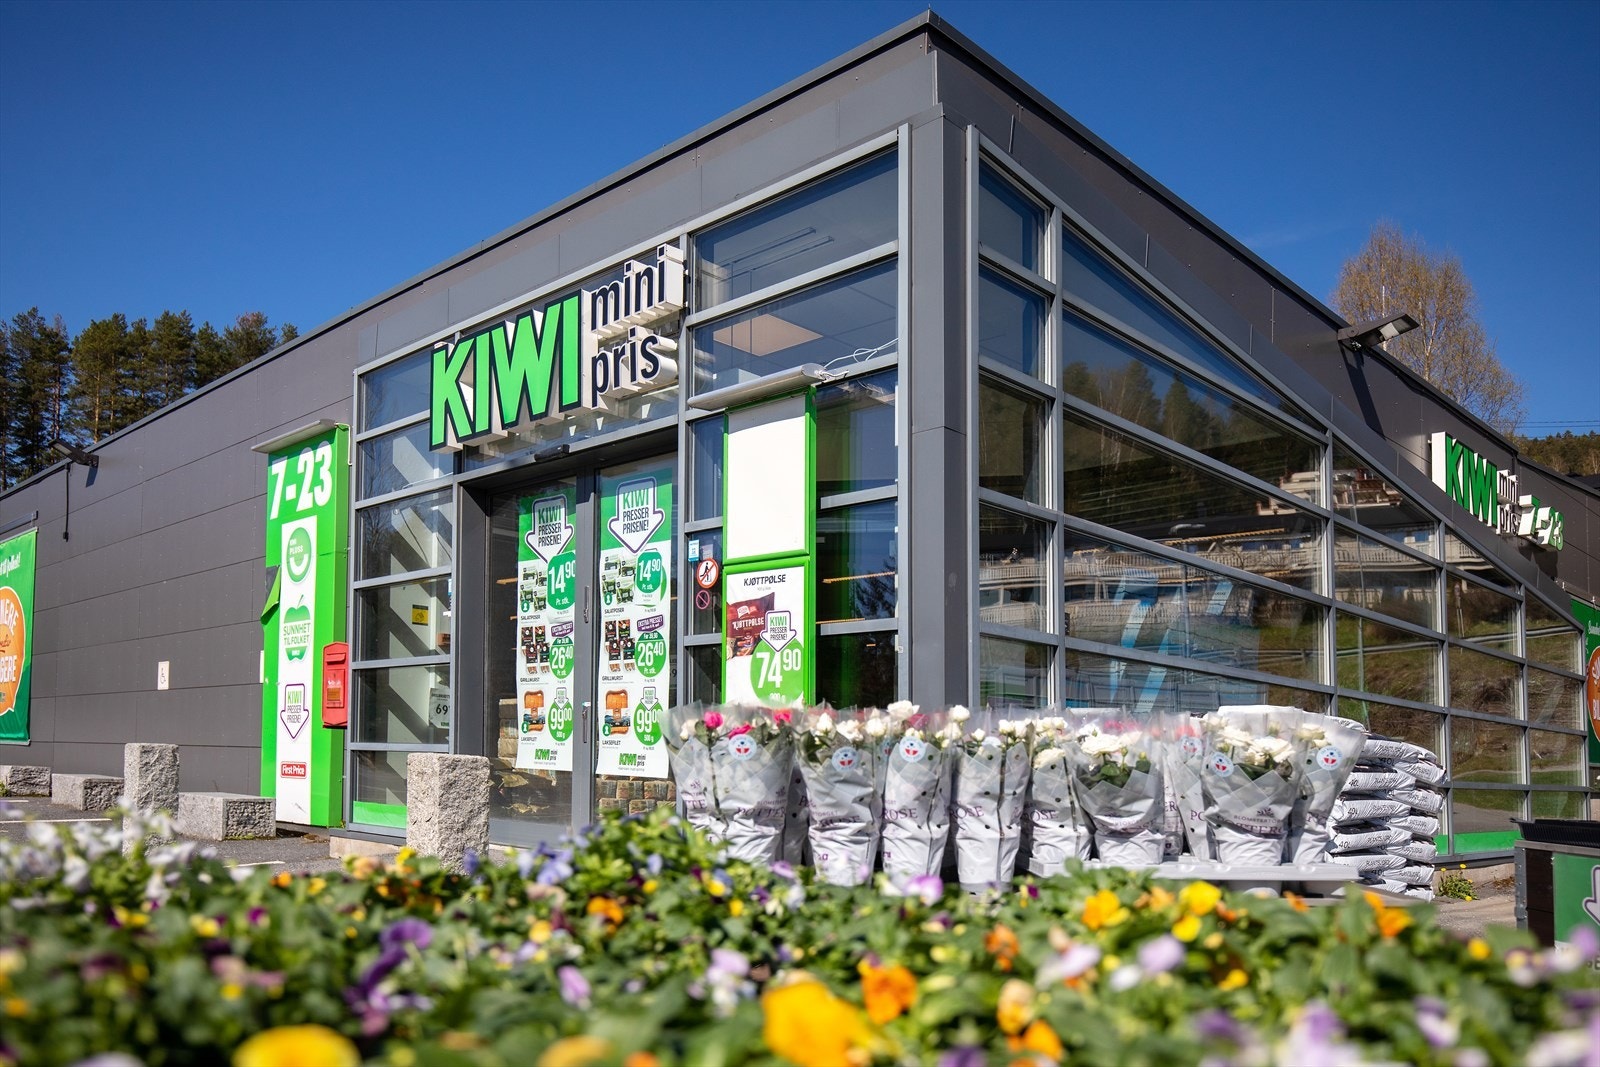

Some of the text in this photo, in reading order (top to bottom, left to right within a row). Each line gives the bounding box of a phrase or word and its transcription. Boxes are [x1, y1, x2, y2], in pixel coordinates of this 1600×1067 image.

[590, 243, 668, 333] mini
[429, 289, 583, 451] KIWI
[591, 325, 661, 410] pris
[270, 440, 333, 520] 7-23
[1445, 432, 1498, 530] KIWI
[623, 488, 649, 509] KIWI
[538, 505, 561, 524] KIWI
[622, 507, 649, 522] PRESSER
[538, 523, 561, 536] PRESSER
[622, 520, 649, 534] PRISENE!
[538, 534, 561, 547] PRISENE!
[743, 574, 786, 586] KJØTTPØLSE
[770, 616, 787, 626] KIWI
[283, 622, 311, 636] SUNNHET
[287, 691, 302, 704] KIWI
[535, 749, 550, 760] KIWI
[619, 753, 637, 765] KIWI
[282, 765, 293, 774] First
[880, 807, 918, 820] ROSE
